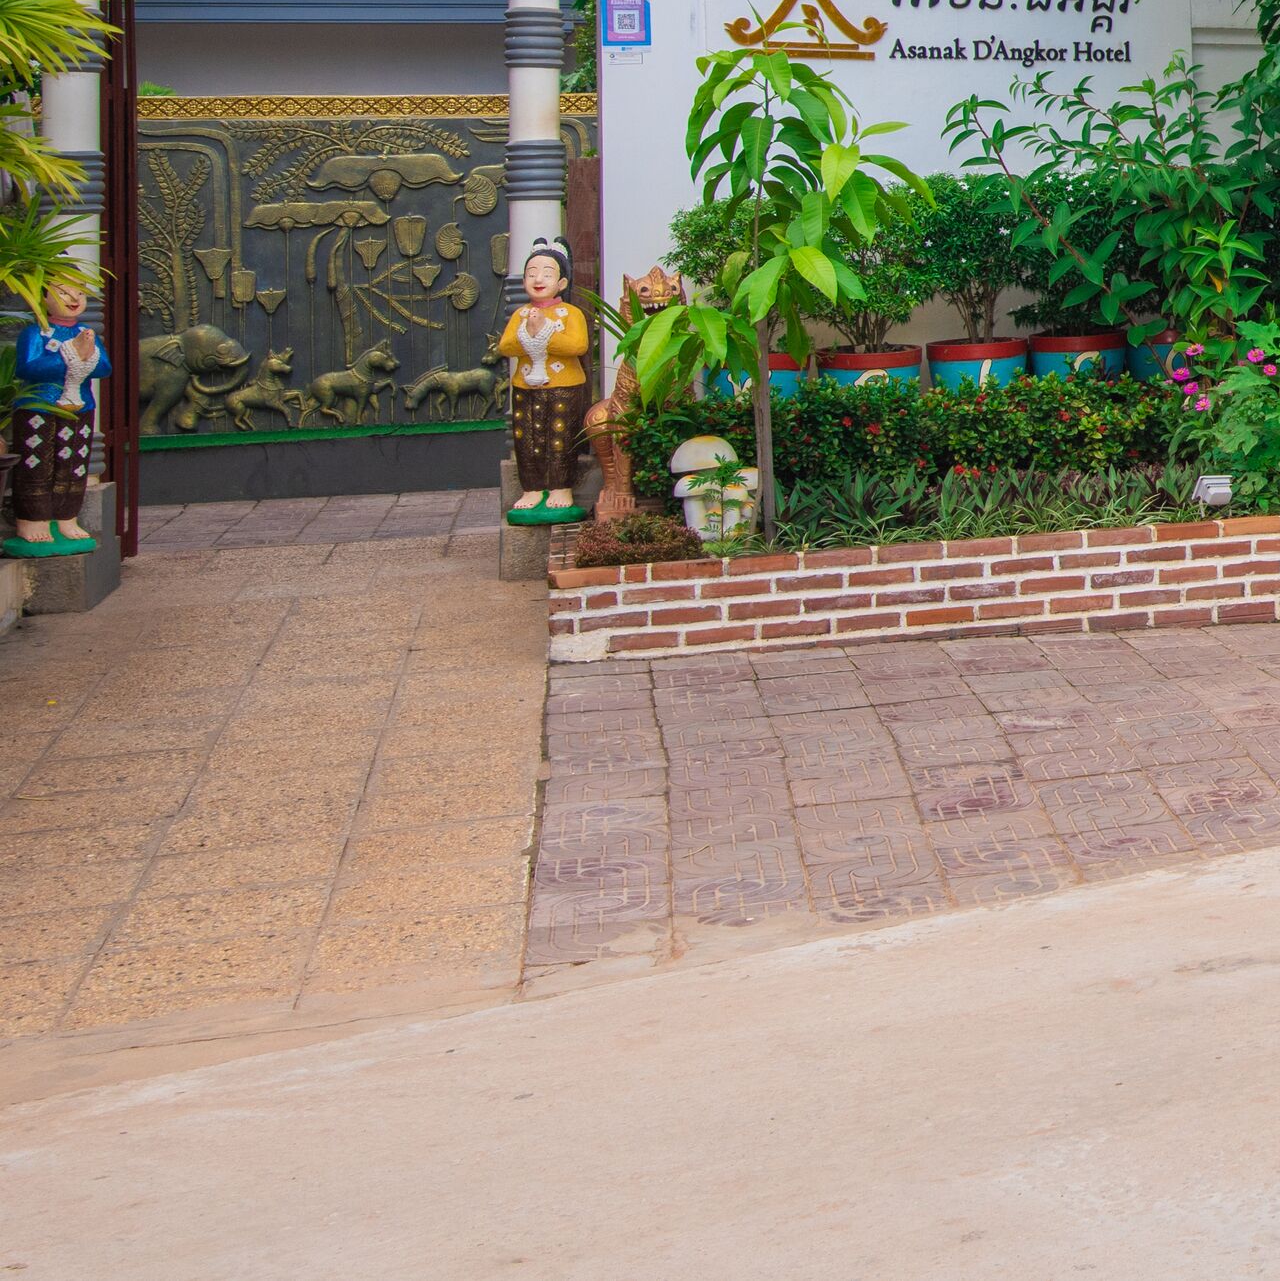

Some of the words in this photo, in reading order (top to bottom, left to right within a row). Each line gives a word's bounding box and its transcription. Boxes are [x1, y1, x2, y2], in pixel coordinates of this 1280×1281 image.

[889, 37, 968, 60] Asanak
[972, 35, 1068, 69] D'Angkor
[1073, 40, 1132, 63] Hotel
